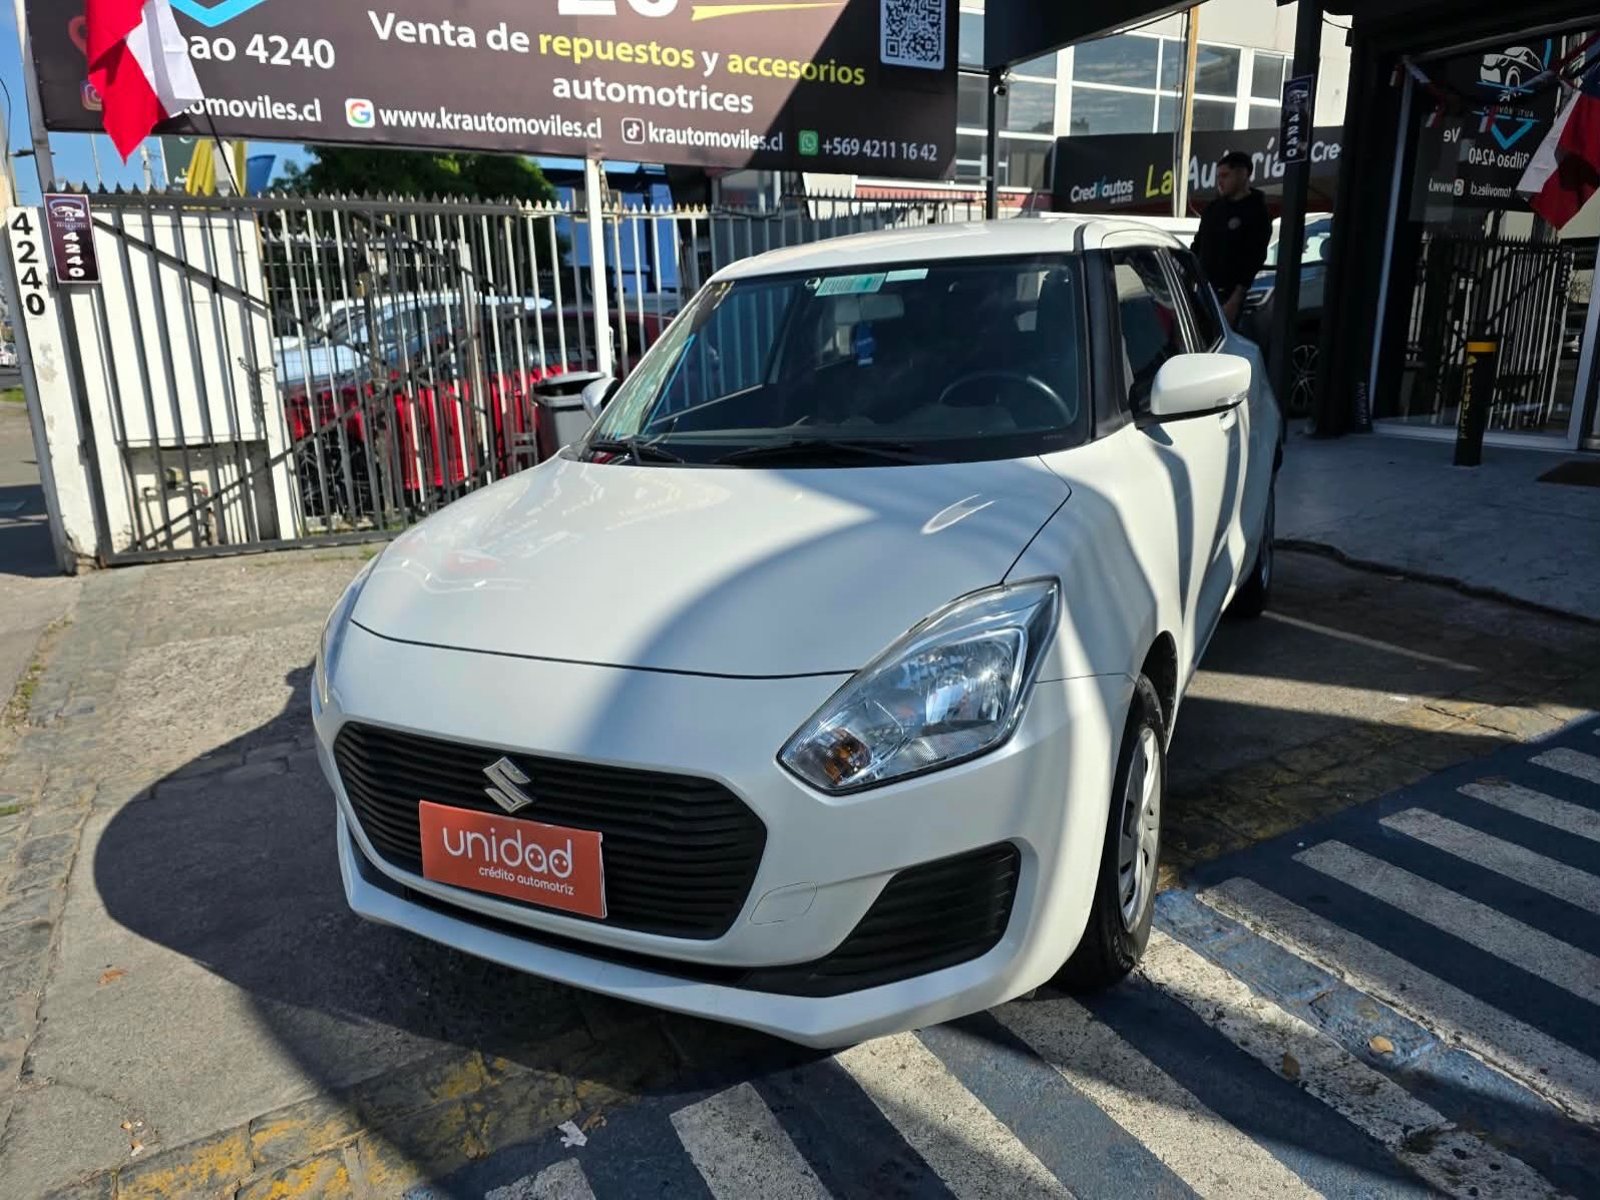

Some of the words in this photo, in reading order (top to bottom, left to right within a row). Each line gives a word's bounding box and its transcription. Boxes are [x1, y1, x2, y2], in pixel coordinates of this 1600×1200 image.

[245, 33, 336, 69] 4240
[367, 10, 477, 48] Venta
[486, 23, 530, 52] de
[539, 33, 695, 68] repuestos
[702, 50, 719, 77] y
[727, 53, 866, 86] accesorios
[553, 77, 754, 114] automotrices
[379, 107, 602, 139] www.krautomoviles.cl
[648, 121, 783, 151] krautomoviles.cl
[822, 137, 860, 156] +569
[862, 139, 897, 158] 4211
[901, 142, 918, 160] 16
[920, 144, 938, 161] 42
[1286, 113, 1300, 157] 4240
[1146, 164, 1173, 198] La
[11, 211, 46, 316] 4240
[62, 232, 85, 278] 4240
[442, 827, 573, 879] unidad
[478, 865, 515, 882] crédito
[516, 874, 576, 896] automotriz
